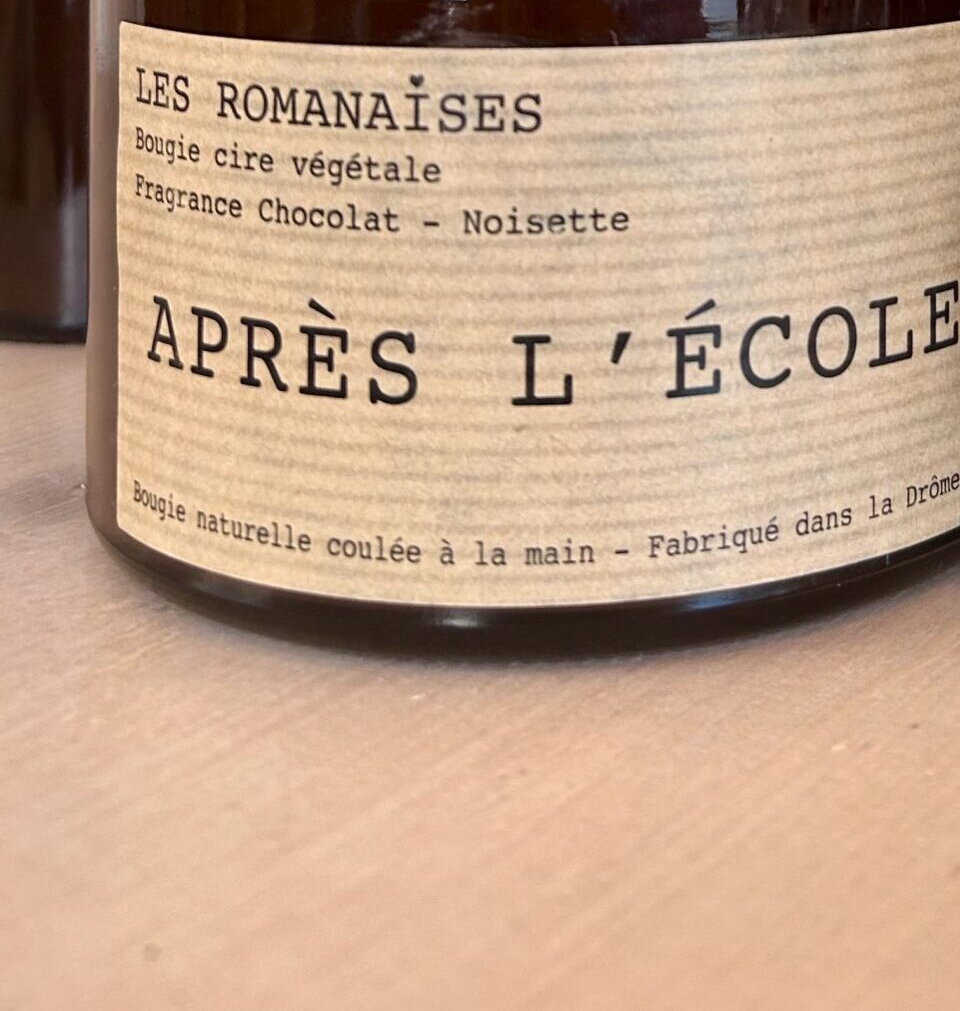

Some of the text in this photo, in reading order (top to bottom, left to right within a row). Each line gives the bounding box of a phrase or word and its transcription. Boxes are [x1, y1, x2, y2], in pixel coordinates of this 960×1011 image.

[135, 67, 190, 113] LES
[135, 126, 442, 186] Bougie cire végétale
[135, 173, 243, 218] Fragrance
[258, 196, 401, 233] Chocolat
[462, 205, 630, 235] Noisette
[147, 294, 418, 407] APRÈS
[133, 479, 187, 521] Bougie
[196, 508, 312, 552] naturelle
[327, 536, 422, 563] coulée
[440, 539, 455, 566] à
[474, 541, 507, 566] la
[524, 538, 595, 566] main
[648, 515, 780, 558] Fabriqué
[795, 509, 852, 537] dans
[868, 495, 894, 520] la
[906, 473, 960, 508] Drôme
